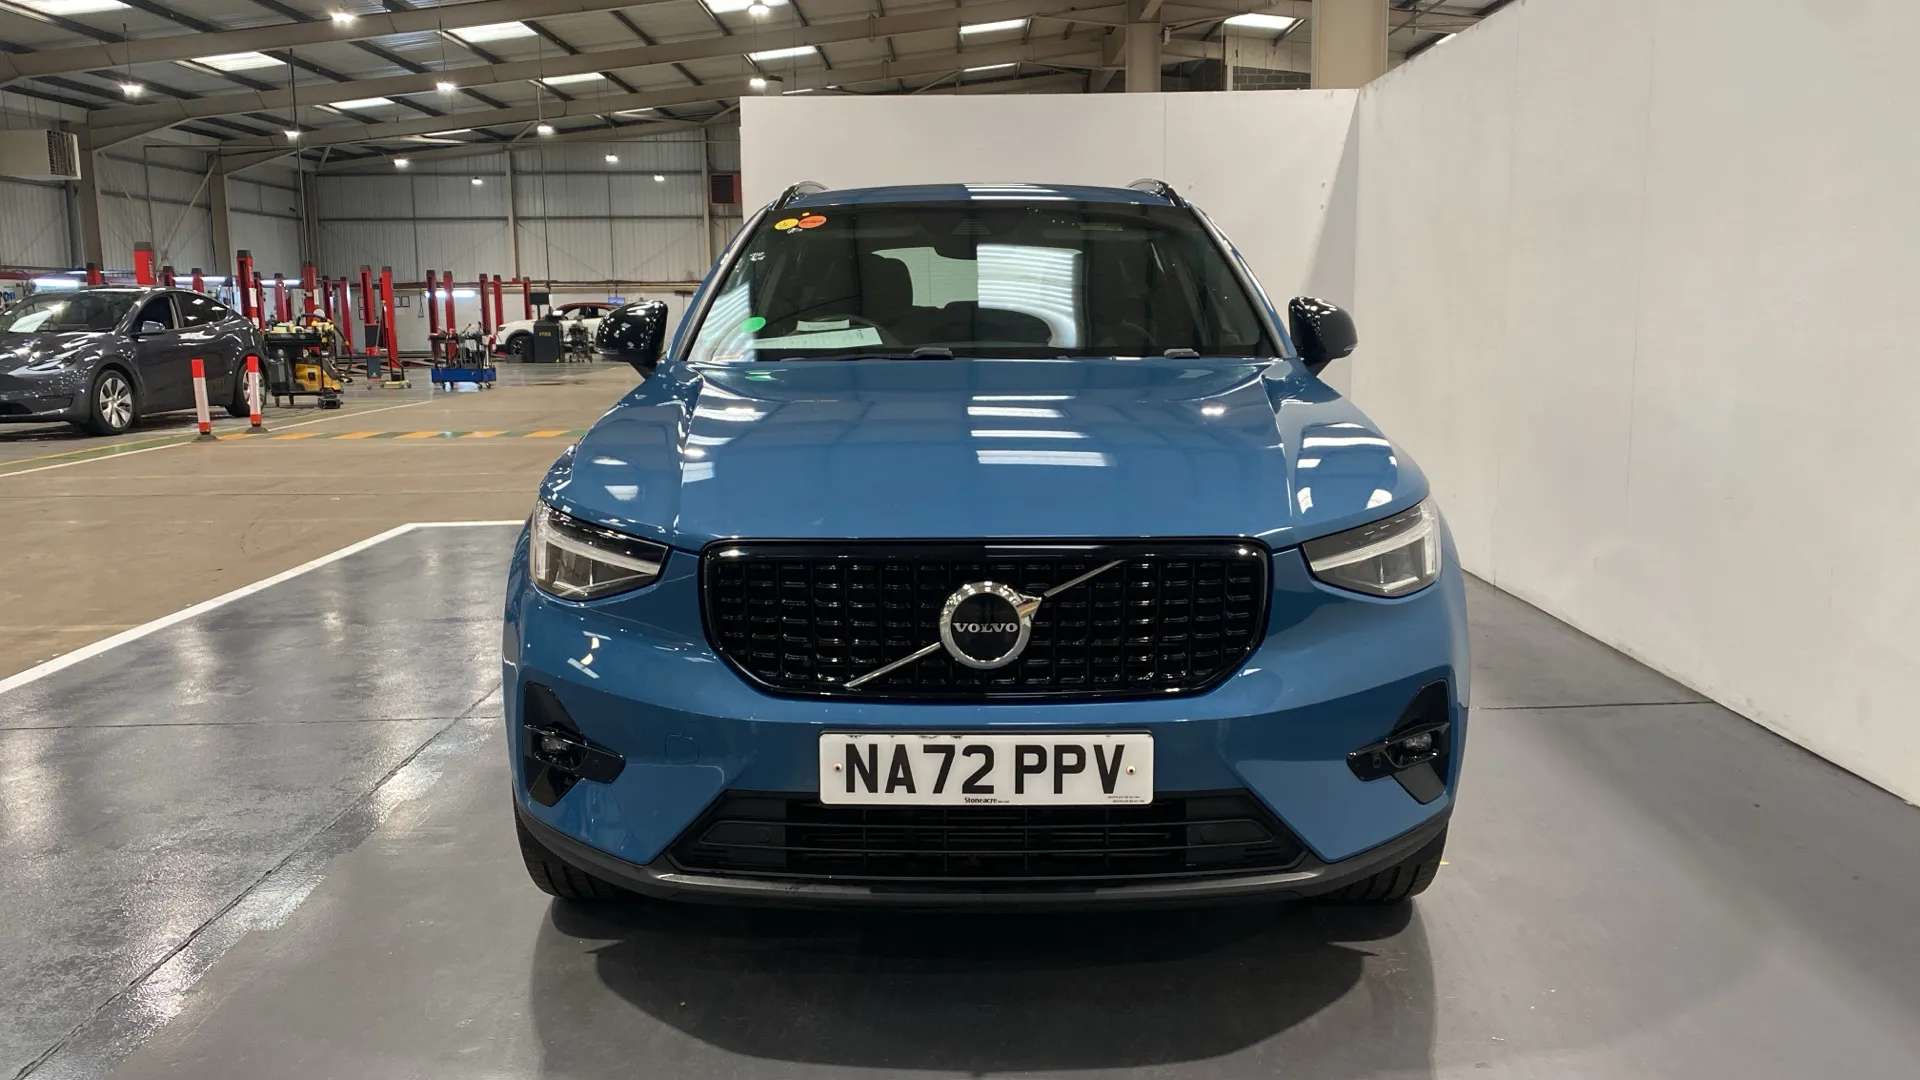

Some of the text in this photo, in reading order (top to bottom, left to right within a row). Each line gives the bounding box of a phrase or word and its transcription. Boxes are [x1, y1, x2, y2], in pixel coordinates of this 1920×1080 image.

[952, 622, 1018, 633] VOLVO
[845, 743, 1125, 795] NA72 PPV
